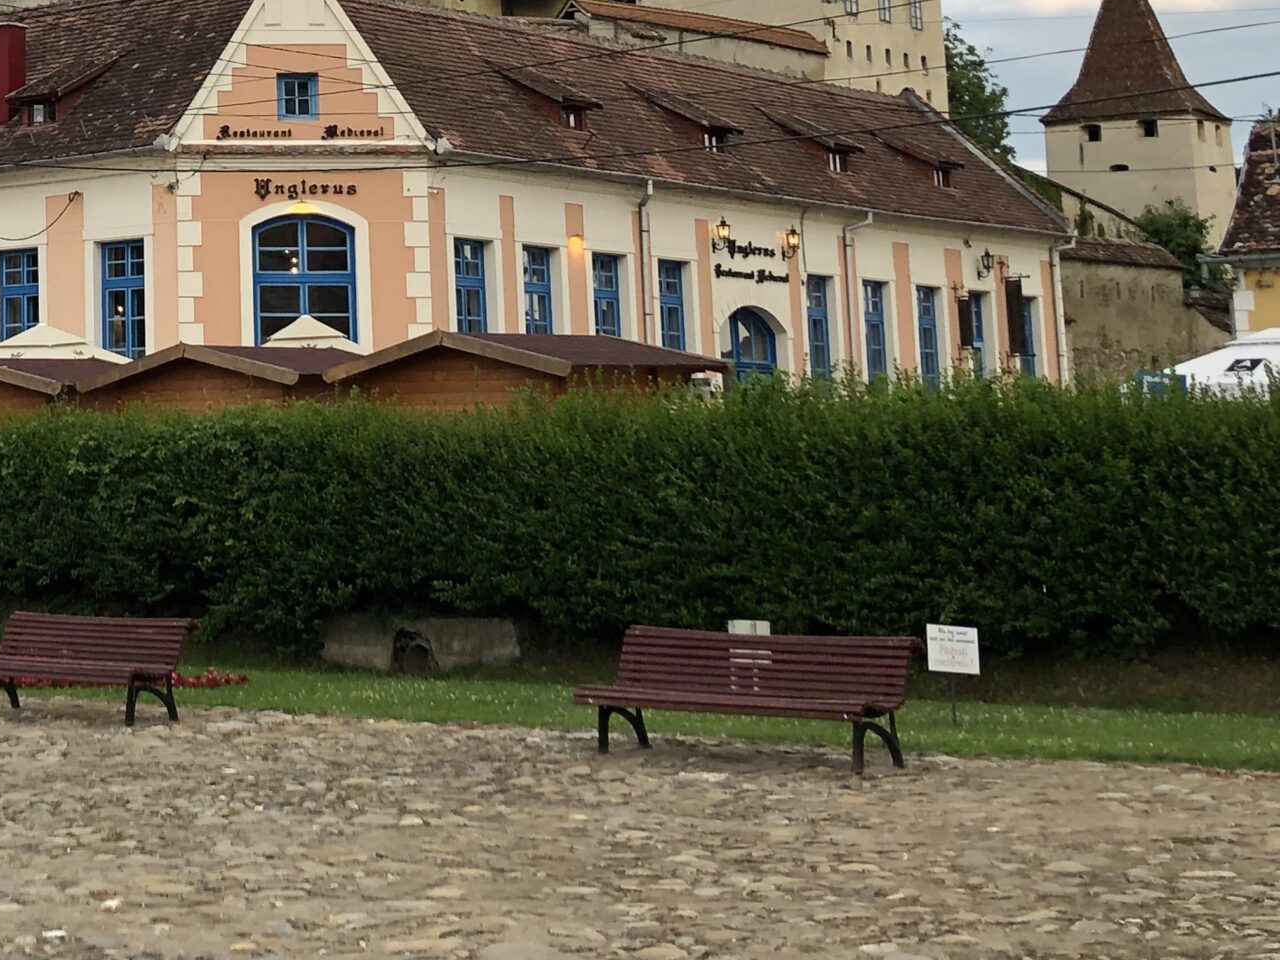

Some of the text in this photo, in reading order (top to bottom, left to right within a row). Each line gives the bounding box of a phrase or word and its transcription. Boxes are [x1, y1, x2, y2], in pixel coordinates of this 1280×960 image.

[216, 124, 385, 141] Restaurant Medieval
[254, 178, 357, 201] Unglerus
